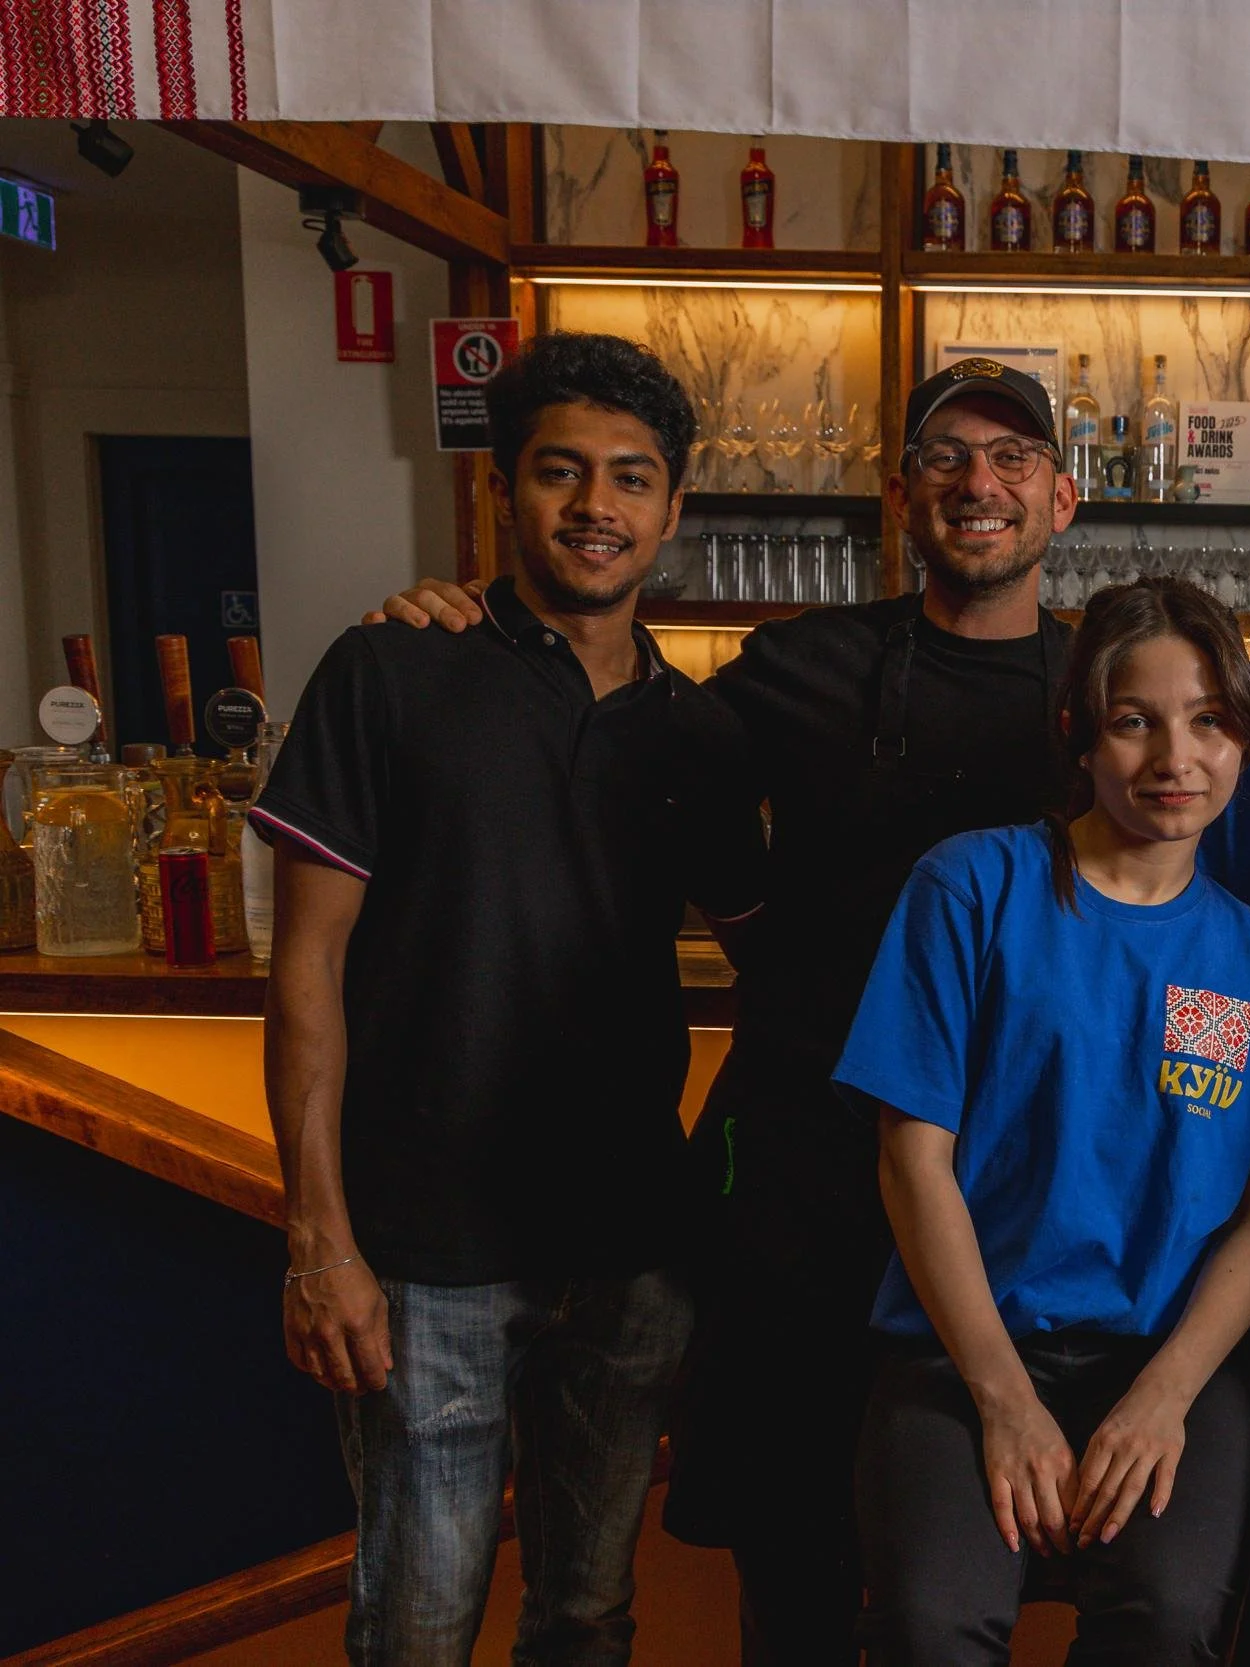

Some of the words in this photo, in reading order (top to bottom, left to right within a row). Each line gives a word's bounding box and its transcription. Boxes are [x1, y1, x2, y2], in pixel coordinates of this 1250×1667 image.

[1188, 416, 1216, 429] FOOD
[1187, 430, 1196, 444] &
[1201, 430, 1233, 444] DRINK
[1187, 444, 1233, 458] AWARDS
[1187, 1103, 1212, 1119] SOCIAL
